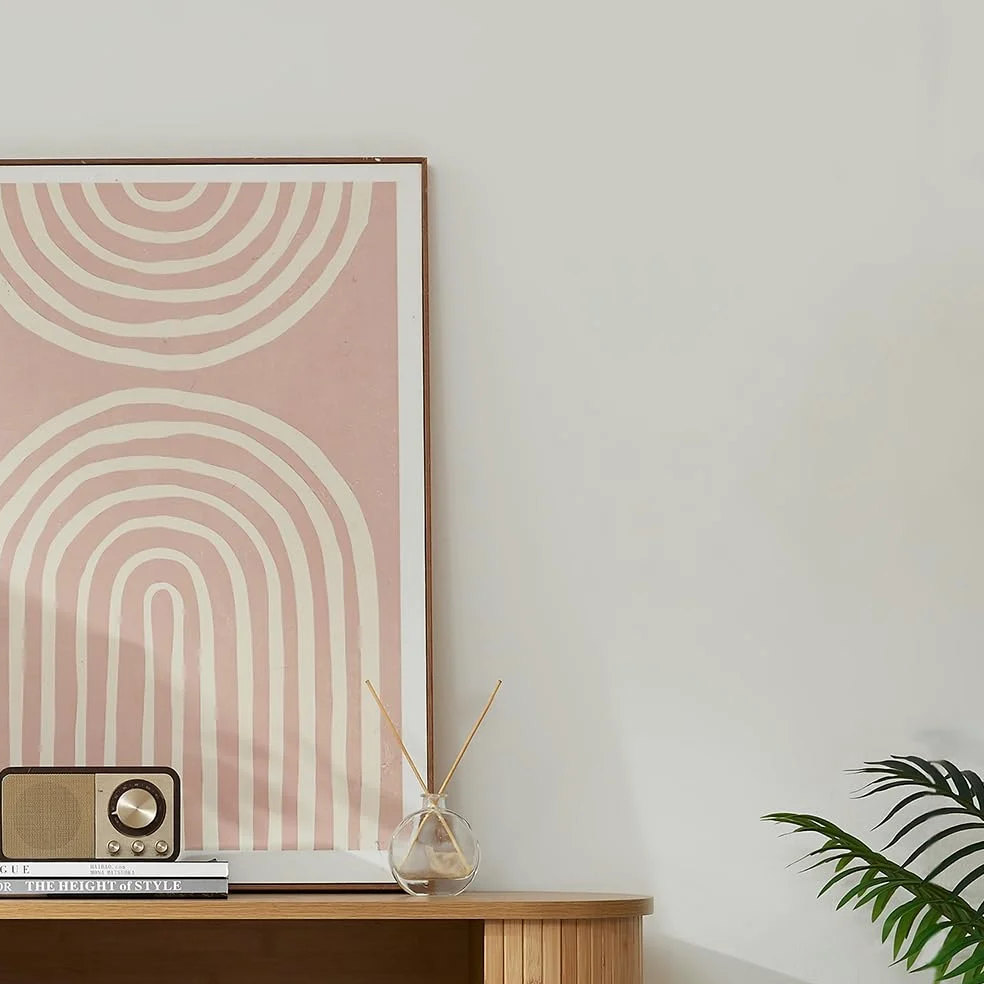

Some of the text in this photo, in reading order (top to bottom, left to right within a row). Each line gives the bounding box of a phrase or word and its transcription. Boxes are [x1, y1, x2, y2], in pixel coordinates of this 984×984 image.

[24, 881, 55, 892] THE
[58, 881, 116, 892] HEIGHT
[119, 881, 132, 892] of
[134, 881, 182, 892] STYLE
